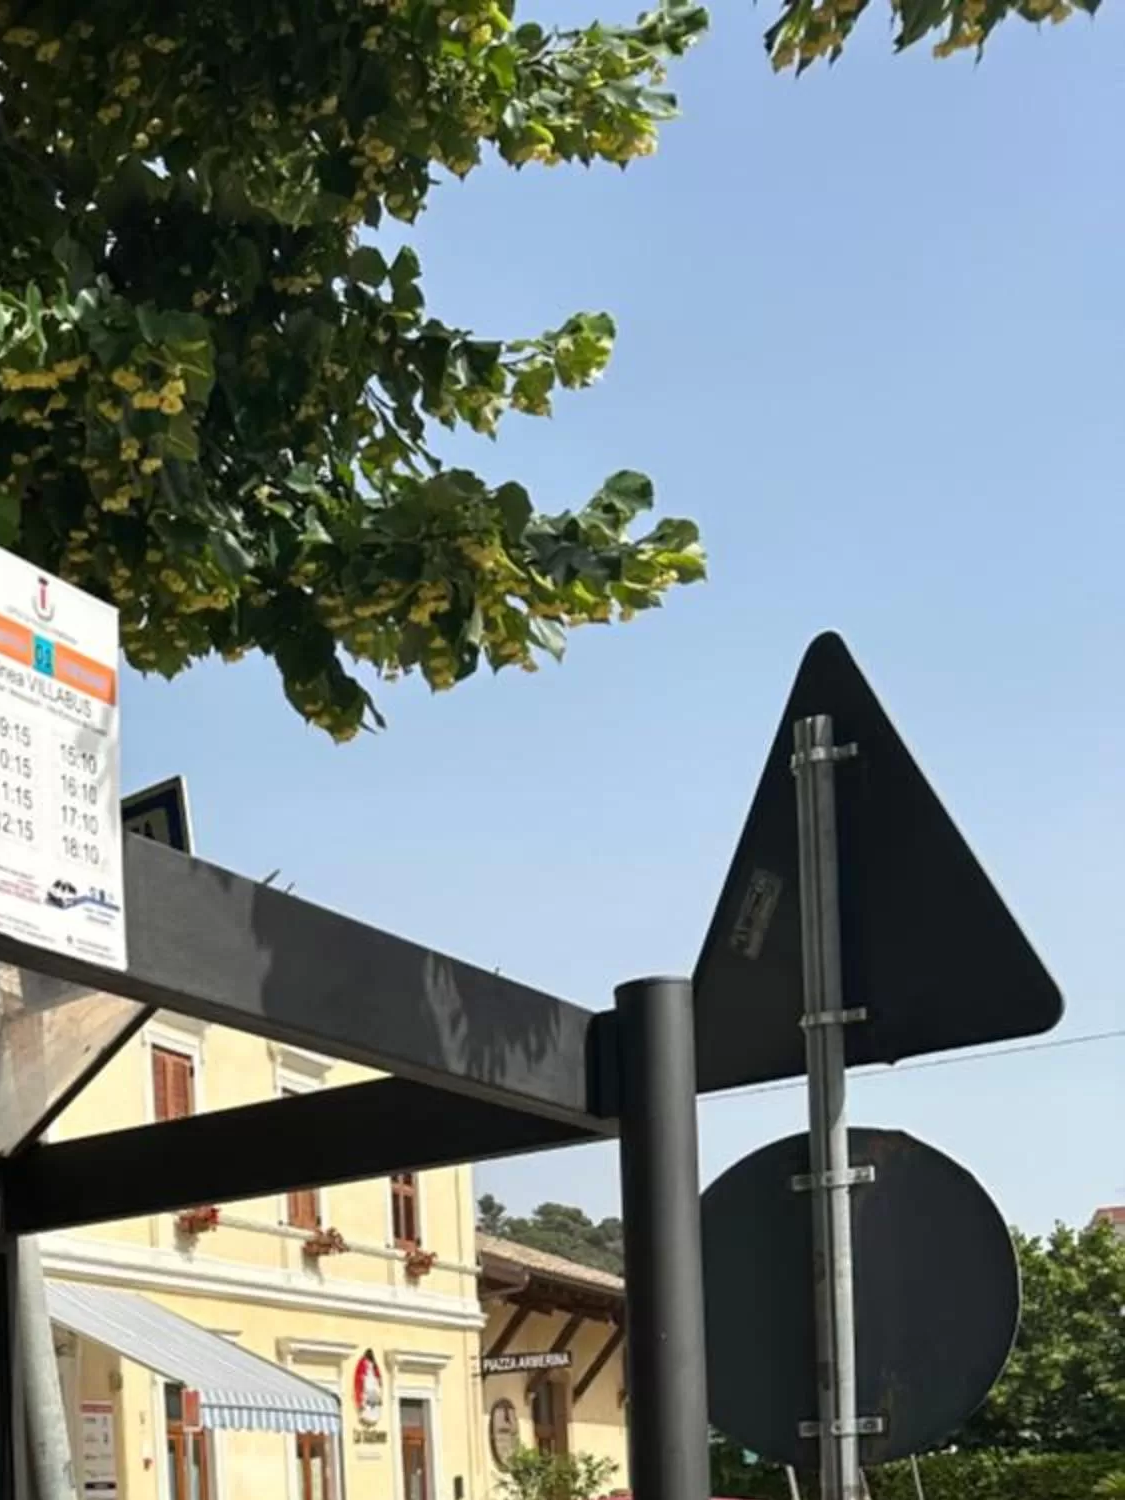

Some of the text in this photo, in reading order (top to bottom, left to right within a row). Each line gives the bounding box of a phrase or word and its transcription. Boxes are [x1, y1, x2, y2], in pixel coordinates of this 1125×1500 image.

[28, 676, 92, 719] VILLABUS
[60, 744, 97, 775] 15:10
[60, 774, 97, 805] 16:10
[61, 804, 99, 835] 17:10
[63, 835, 99, 865] 18:10
[483, 1357, 515, 1372] PIAZZA
